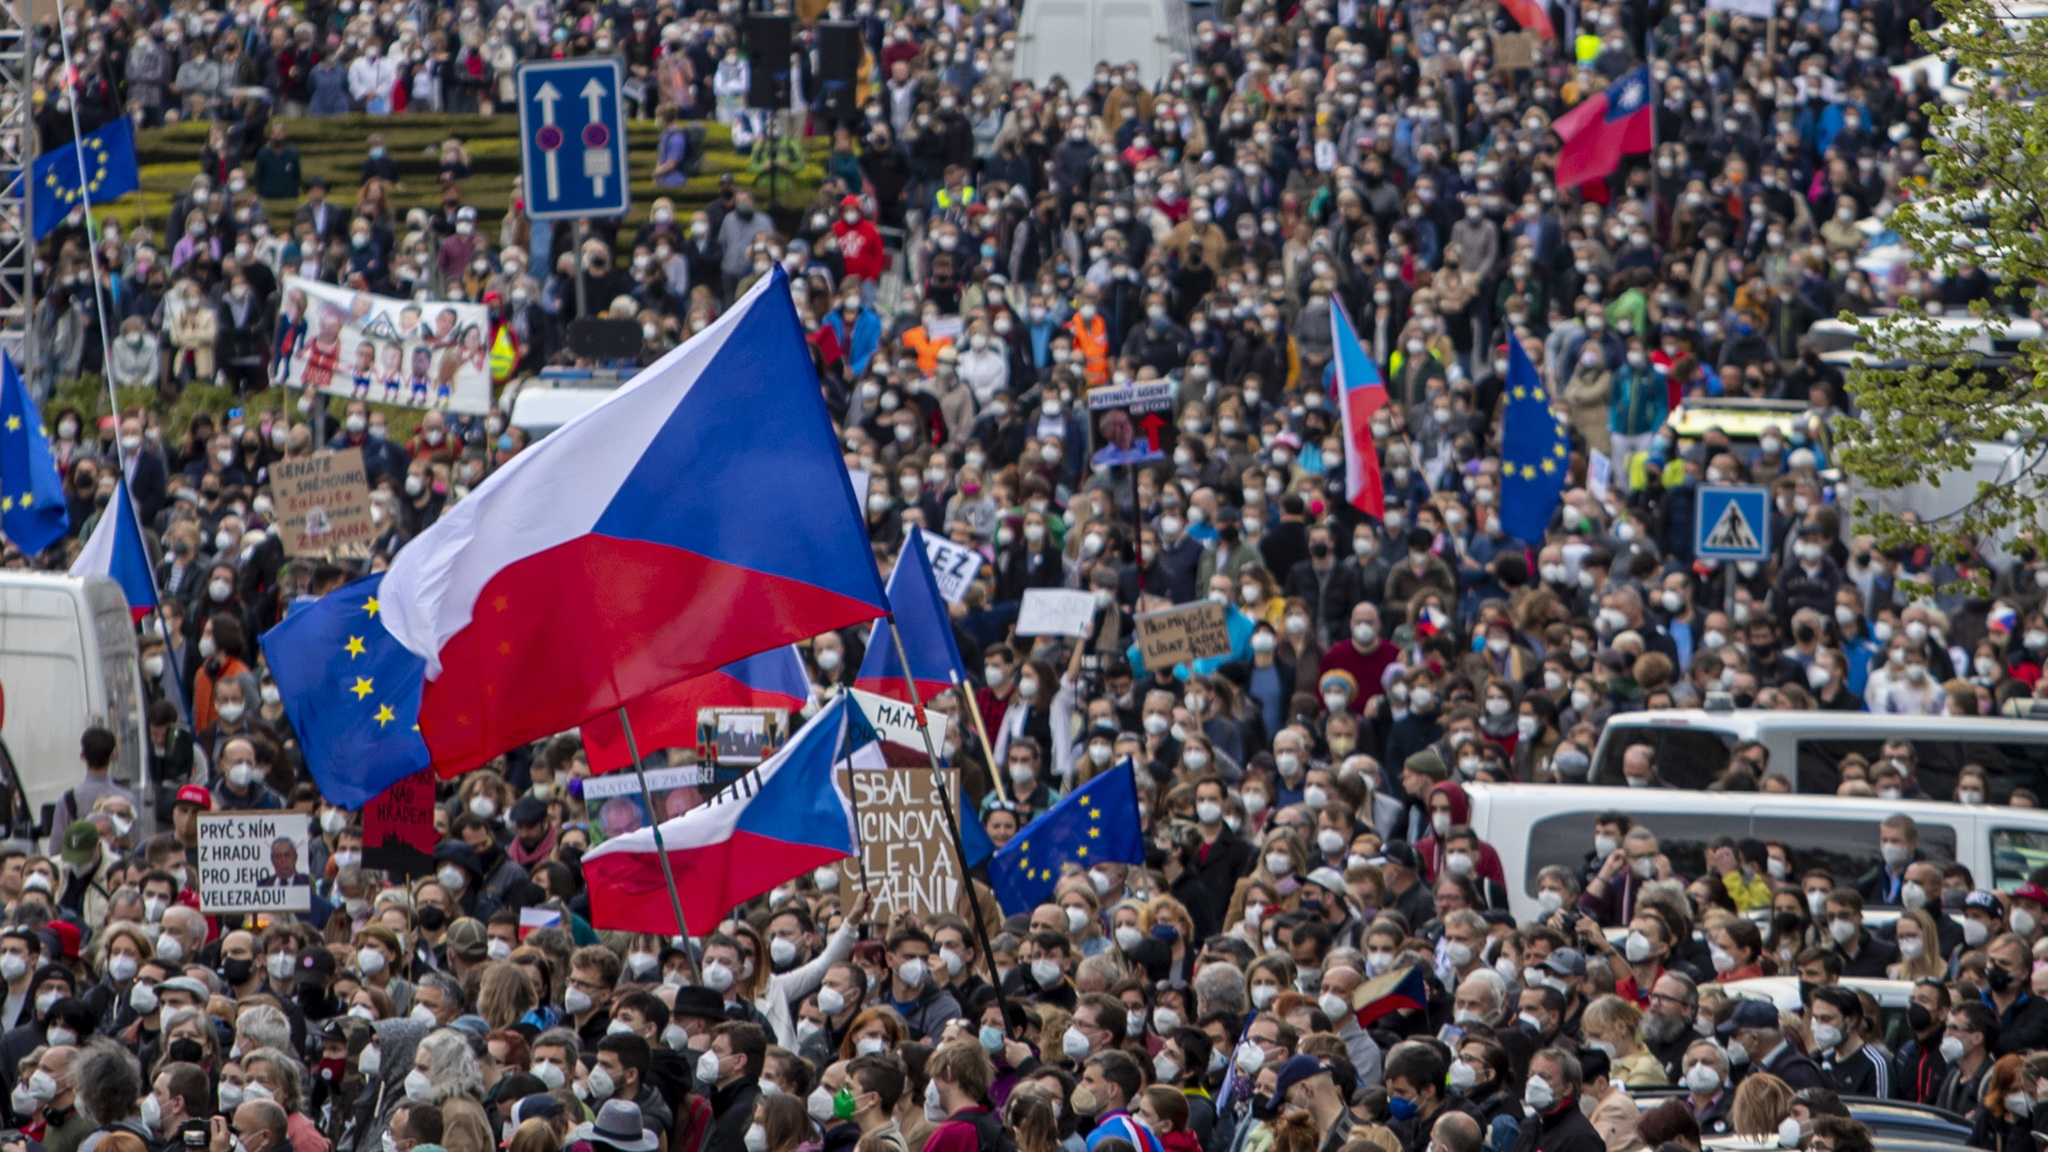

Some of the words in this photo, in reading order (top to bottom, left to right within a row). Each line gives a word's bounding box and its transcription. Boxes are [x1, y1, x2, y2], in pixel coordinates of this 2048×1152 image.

[1137, 383, 1171, 399] AGENT
[297, 521, 369, 550] ZEMANA
[390, 784, 415, 805] NAD
[200, 819, 235, 839] PRYČ
[237, 822, 246, 838] S
[249, 818, 276, 838] NÍM
[200, 845, 208, 862] Z
[212, 845, 261, 861] HRADU
[931, 841, 953, 878] A
[202, 867, 230, 884] PRO
[233, 866, 271, 884] JEHO
[201, 888, 287, 907] VELEZRADU!
